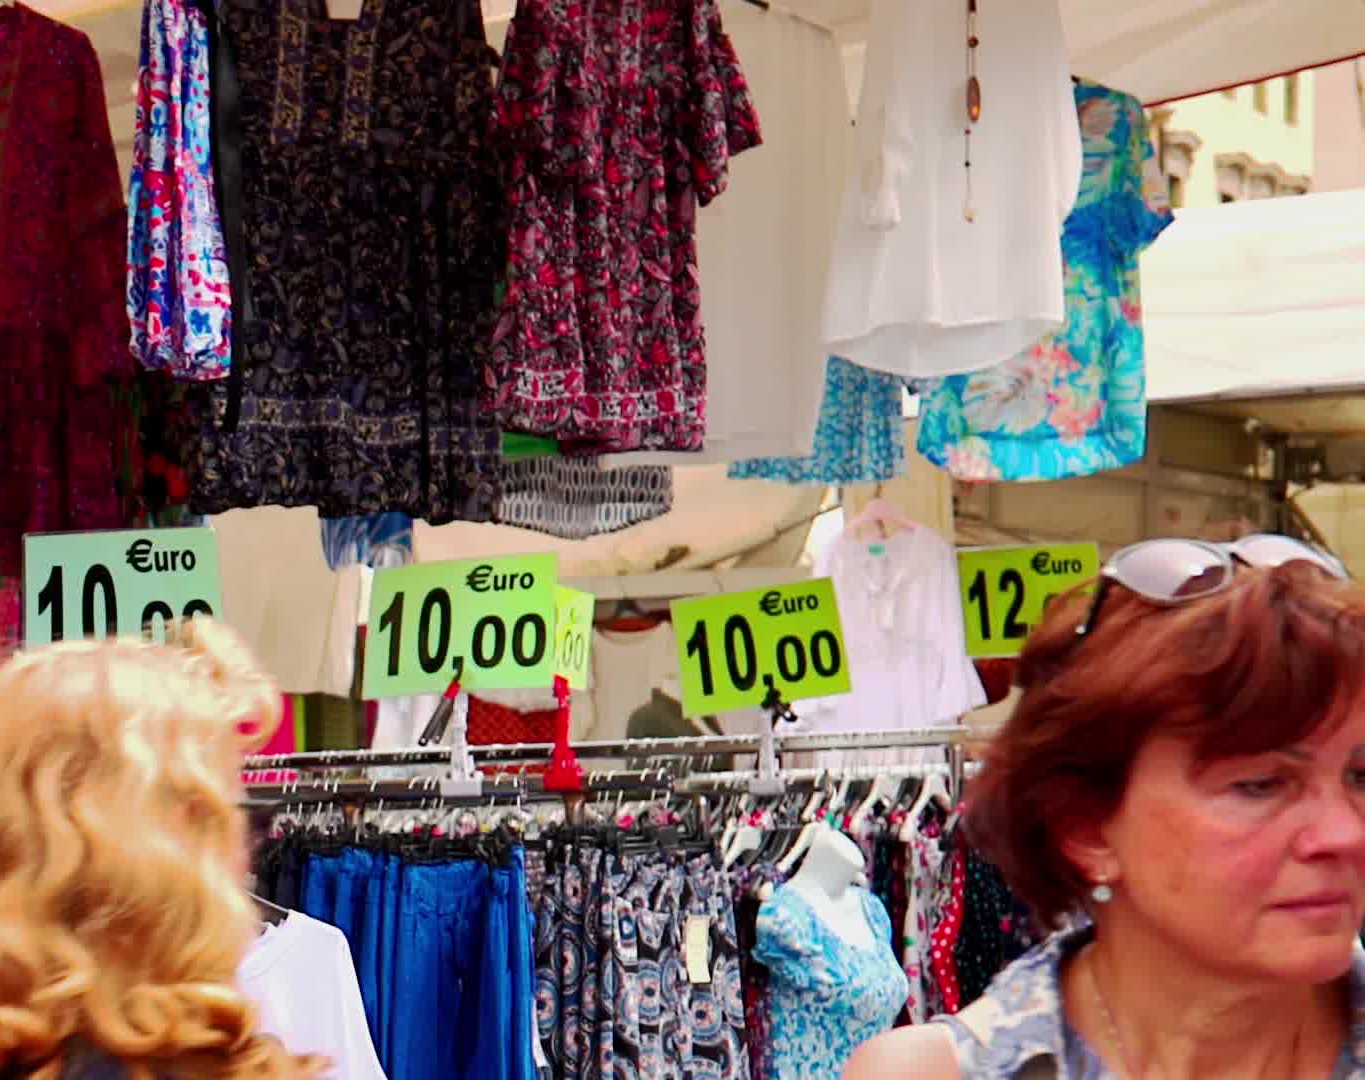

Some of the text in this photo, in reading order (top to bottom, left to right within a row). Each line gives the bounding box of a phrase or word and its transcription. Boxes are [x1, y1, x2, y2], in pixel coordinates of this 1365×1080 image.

[126, 539, 196, 572] €uro
[1031, 552, 1082, 575] €uro
[465, 565, 534, 592] €uro
[759, 591, 819, 616] €uro
[379, 587, 546, 680] 10,00
[686, 614, 841, 699] 10,00
